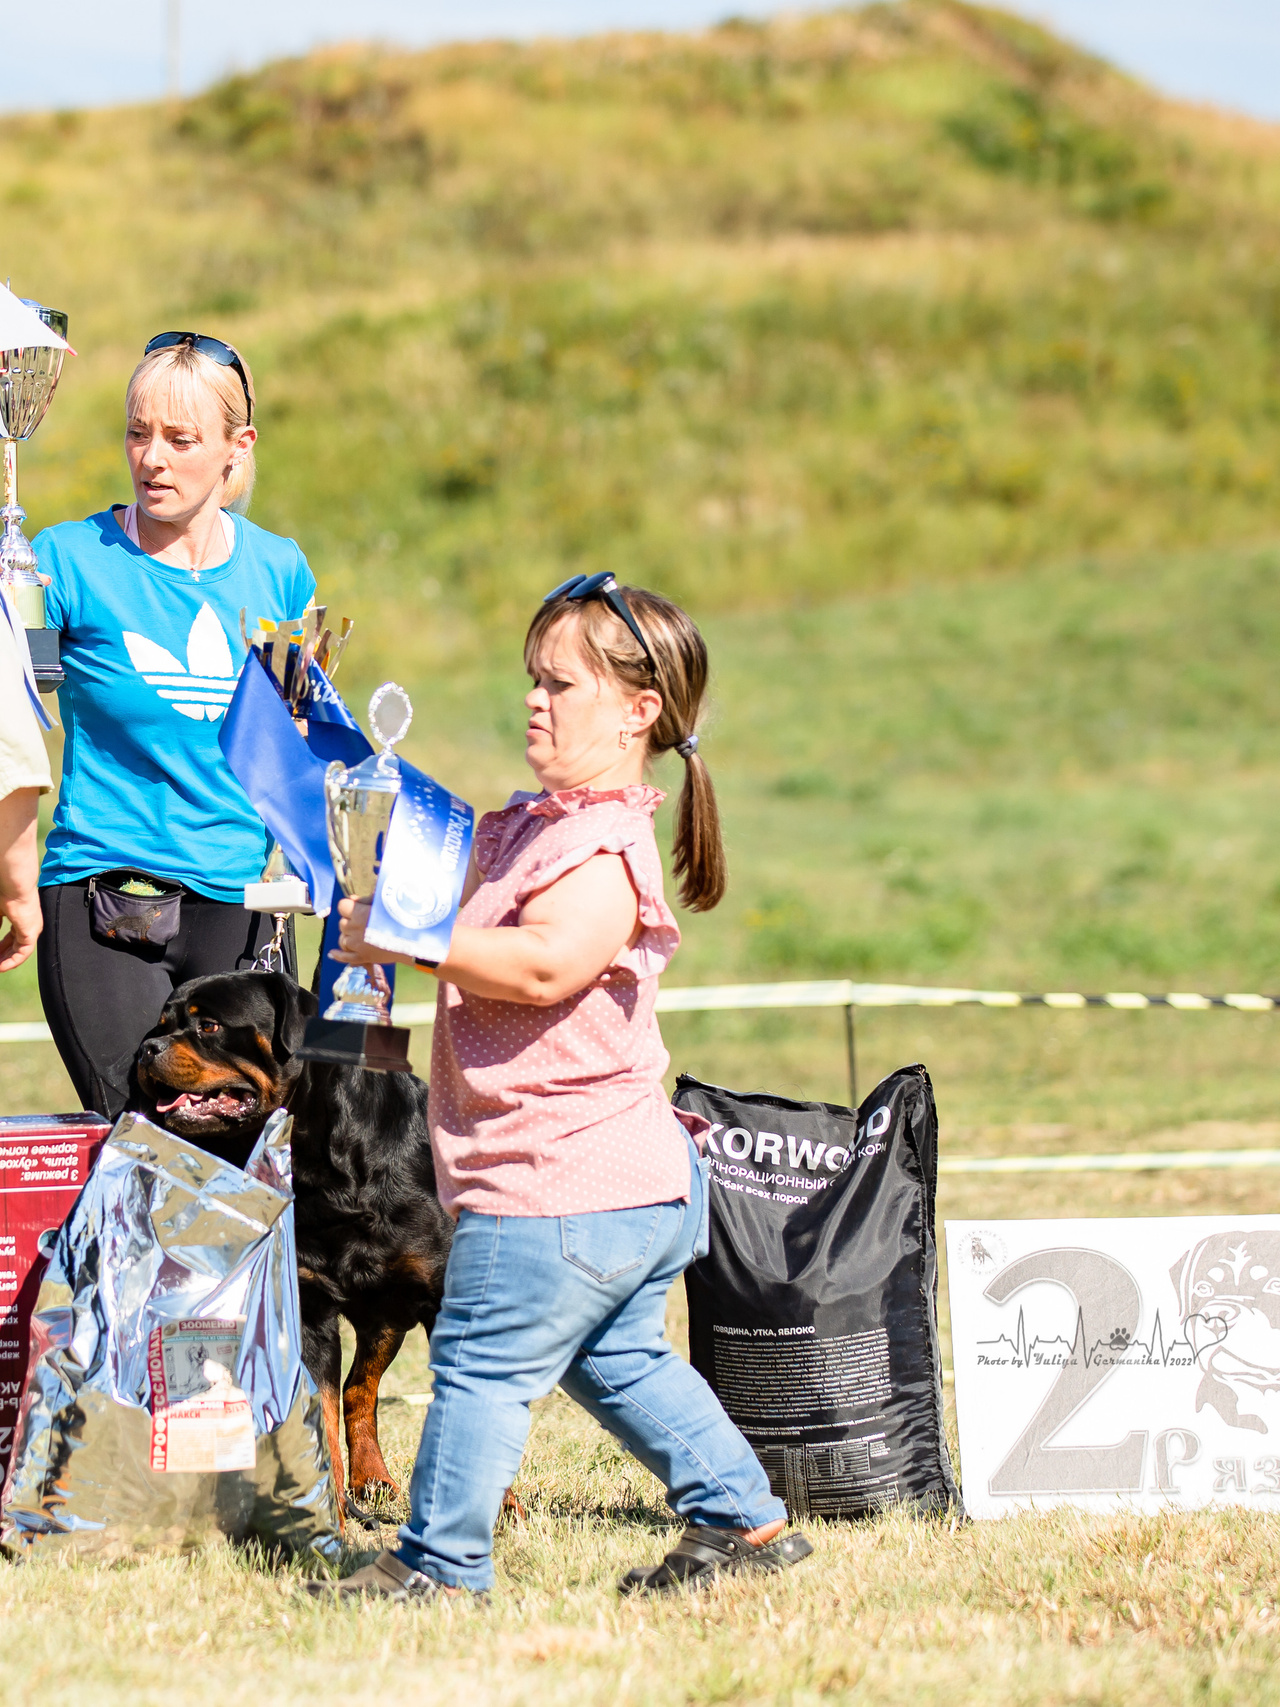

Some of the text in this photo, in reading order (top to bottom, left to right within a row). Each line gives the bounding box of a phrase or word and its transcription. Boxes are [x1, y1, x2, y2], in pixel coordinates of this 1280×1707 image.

[31, 1142, 78, 1155] горячее
[41, 1155, 78, 1168] гриль,
[20, 1167, 79, 1181] 3 режима:
[713, 1174, 744, 1192] собак
[745, 1186, 771, 1200] всех
[772, 1192, 808, 1205] пород
[180, 1320, 235, 1329] ЗООМЕНЮ
[713, 1324, 816, 1337] ГОВЯДИНА, УТКА, ЯБЛОКО
[982, 1246, 1149, 1496] 2
[169, 1410, 201, 1419] МАКСИ
